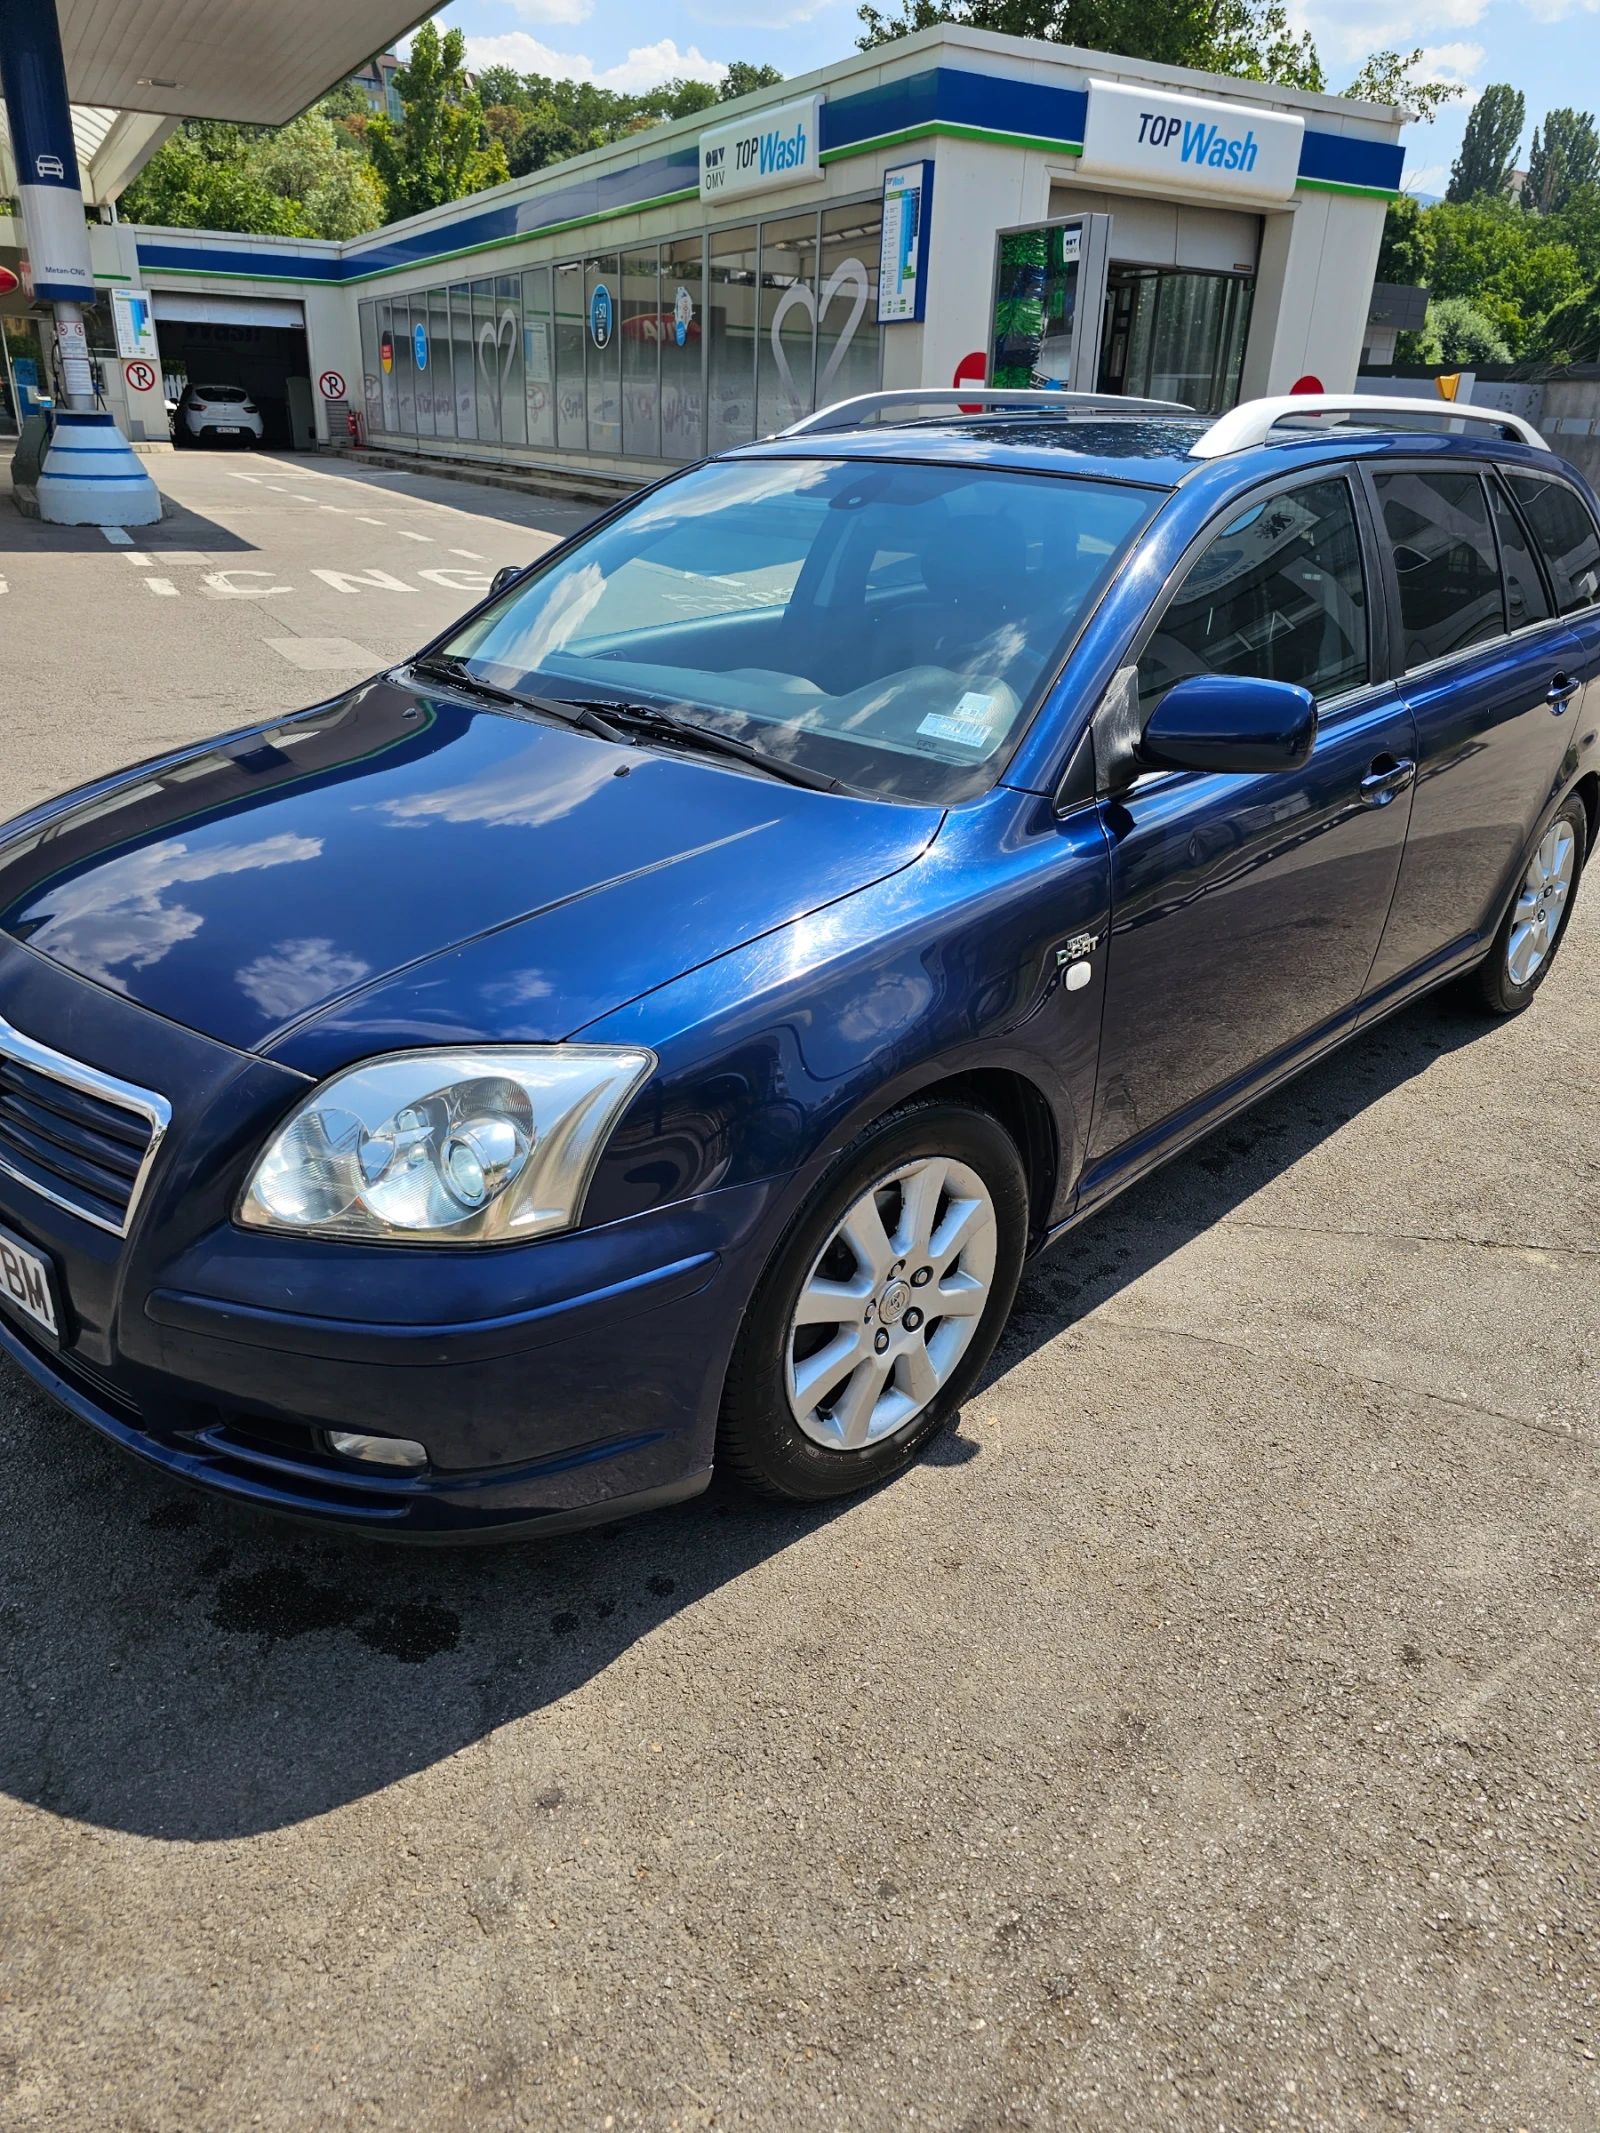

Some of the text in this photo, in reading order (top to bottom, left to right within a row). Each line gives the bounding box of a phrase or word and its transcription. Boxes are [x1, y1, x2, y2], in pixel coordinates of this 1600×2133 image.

[705, 173, 725, 190] OMV
[45, 266, 86, 276] Metan-CNG
[205, 568, 492, 596] CNG
